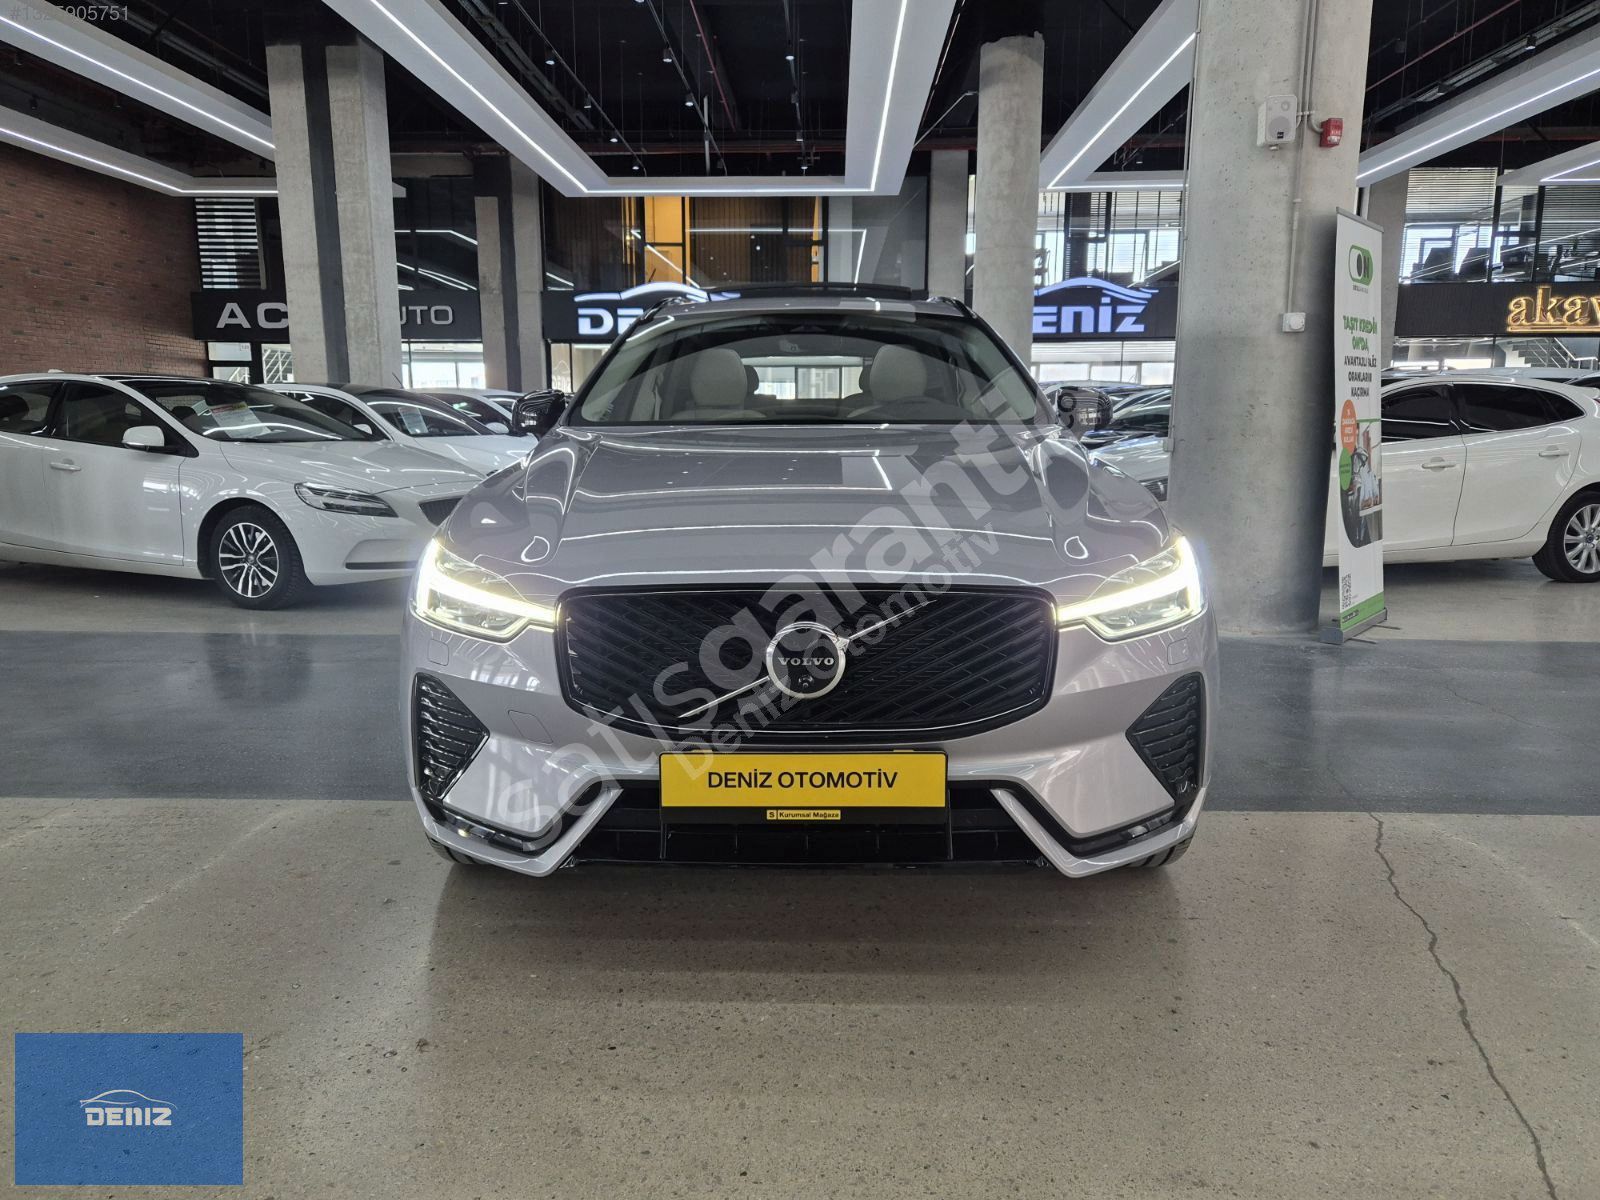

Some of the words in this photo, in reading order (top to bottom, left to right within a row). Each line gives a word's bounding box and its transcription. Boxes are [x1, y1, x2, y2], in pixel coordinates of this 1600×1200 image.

[778, 657, 835, 666] VOLVO
[708, 768, 772, 788] DENİZ
[778, 768, 898, 788] OTOMOTİV
[813, 811, 839, 819] Mağaza
